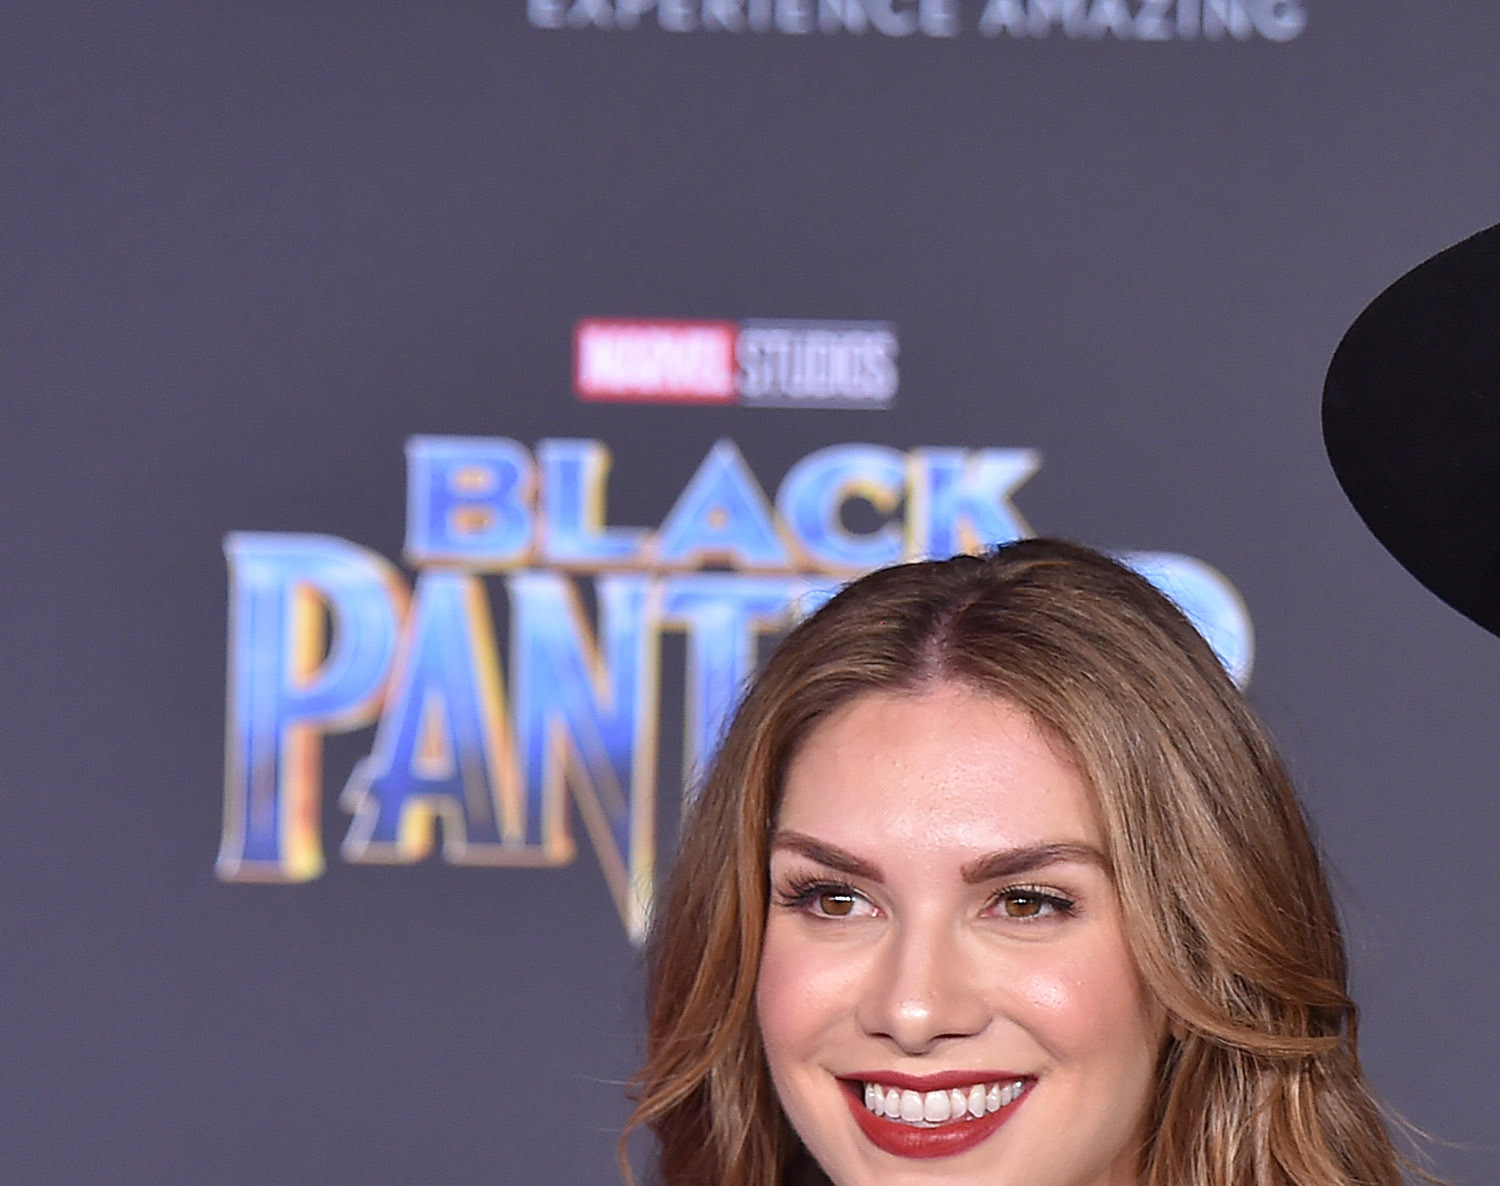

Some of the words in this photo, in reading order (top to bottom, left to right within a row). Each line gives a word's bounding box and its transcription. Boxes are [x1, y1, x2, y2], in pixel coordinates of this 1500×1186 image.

[979, 0, 1307, 42] AMAZING
[579, 321, 733, 397] MARVEL
[738, 327, 899, 400] STUDIOS
[404, 434, 1041, 564] BLACK
[216, 530, 1255, 948] PANT
